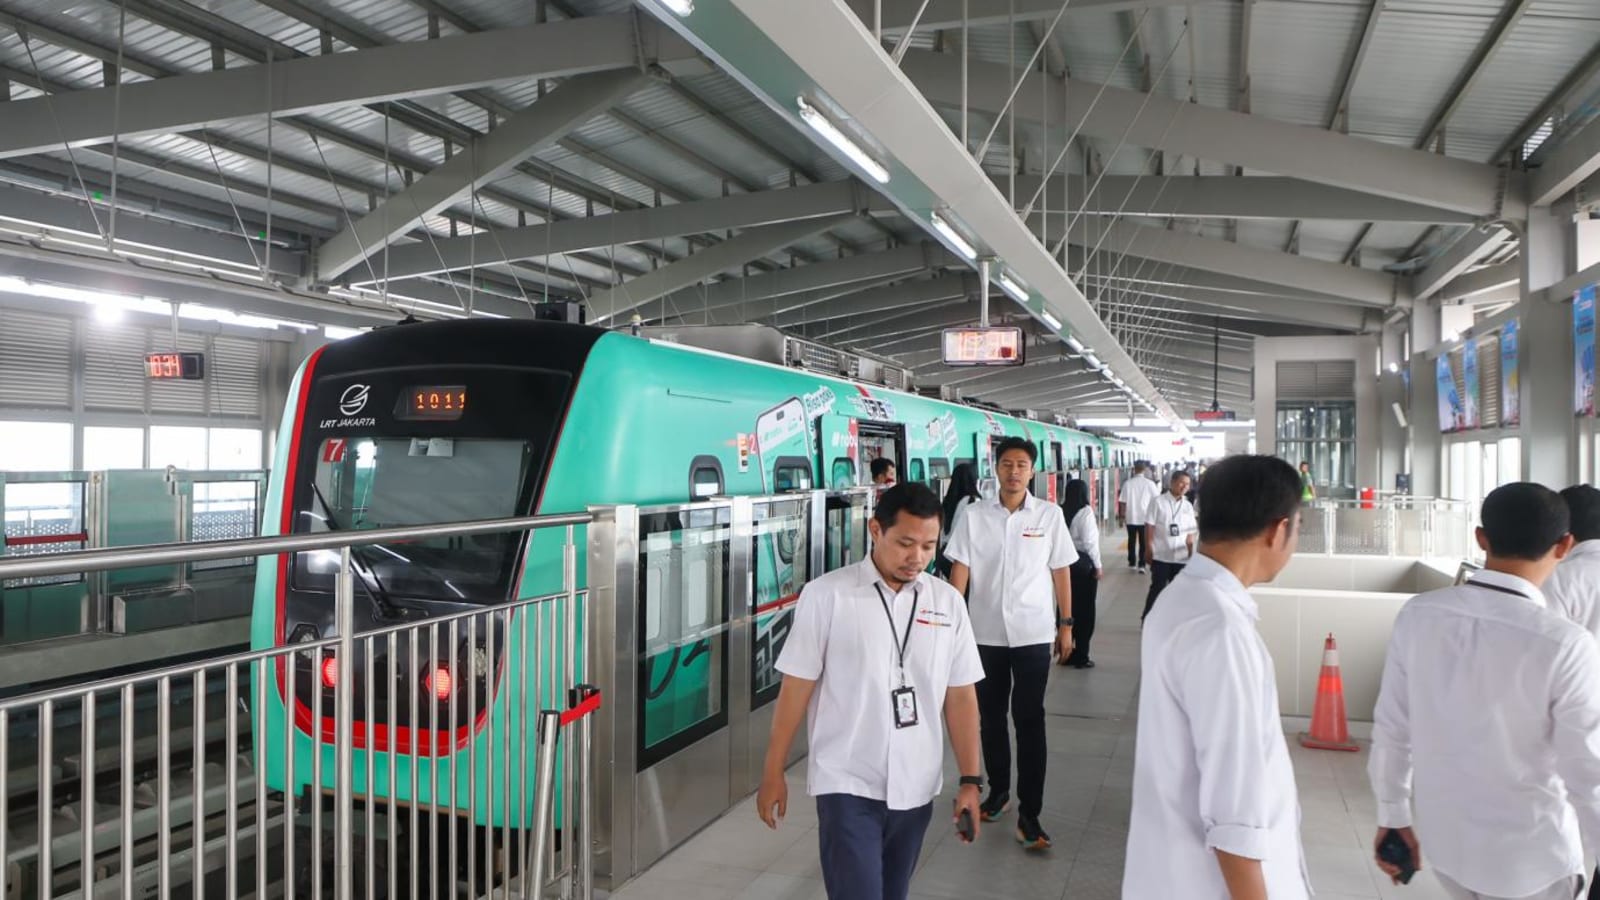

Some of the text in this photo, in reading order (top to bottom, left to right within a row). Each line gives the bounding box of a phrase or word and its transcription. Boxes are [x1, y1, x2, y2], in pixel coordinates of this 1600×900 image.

[417, 393, 465, 409] 1011
[320, 418, 376, 428] LRT JAKARTA
[330, 439, 343, 461] 7
